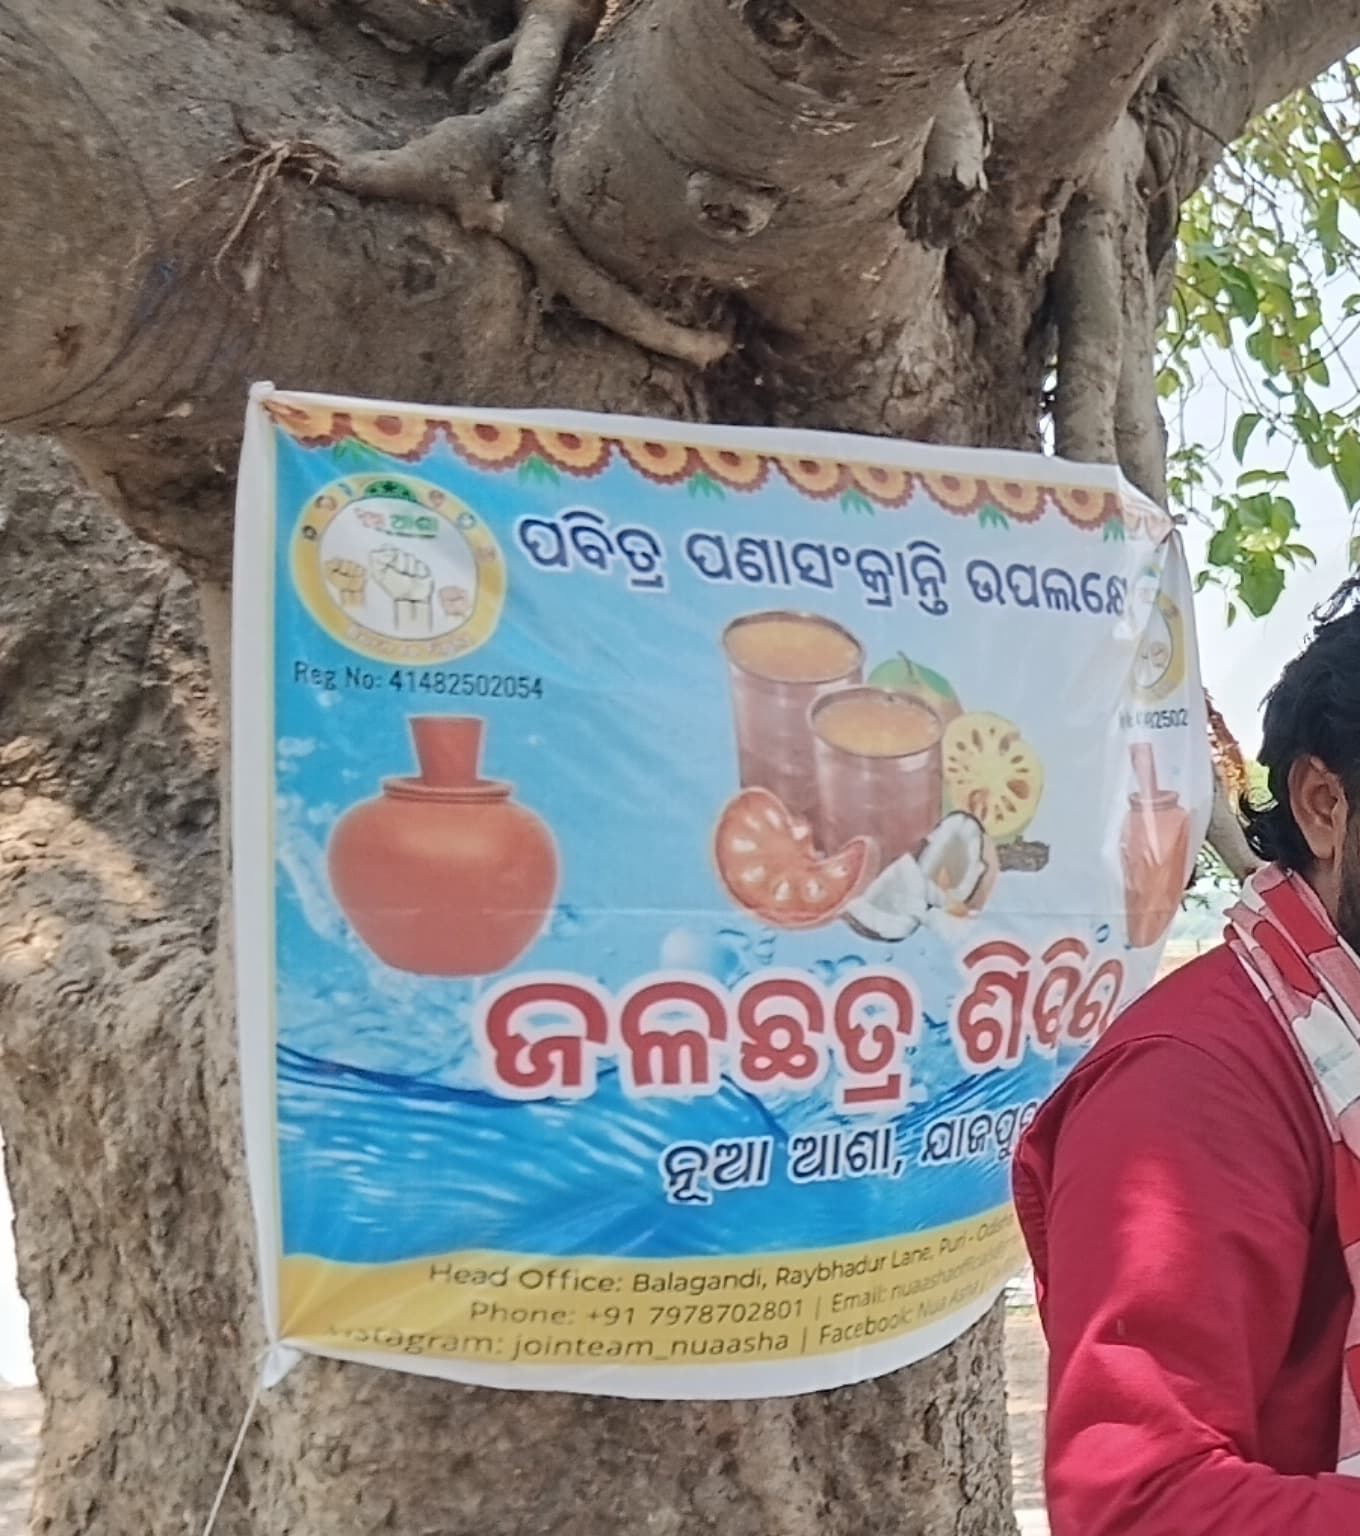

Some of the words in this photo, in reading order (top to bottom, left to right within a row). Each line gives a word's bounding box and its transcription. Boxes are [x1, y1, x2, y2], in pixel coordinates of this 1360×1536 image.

[518, 510, 664, 588] ପବିତ୍ର
[686, 532, 949, 616] ପଣାସଂକ୍ରାନ୍ତି
[294, 661, 338, 691] Reg
[346, 666, 381, 689] No:
[389, 670, 544, 697] 41482502054
[486, 975, 914, 1105] ଜଳଛତ୍ର
[664, 1140, 769, 1203] ନୂଆ
[789, 1127, 905, 1179] ଆଶା,
[430, 1263, 510, 1287] Head
[519, 1268, 623, 1293] Office:
[633, 1269, 767, 1296] Balagandi,
[776, 1254, 887, 1288] Raybhadur
[470, 1301, 575, 1325] Phone:
[588, 1305, 634, 1326] +91
[650, 1298, 803, 1326] 7978702801
[832, 1284, 887, 1314] Email:
[328, 1324, 504, 1355] stagram:
[511, 1331, 789, 1361] jointeam_nuaasha
[819, 1309, 913, 1346] Facebook:
